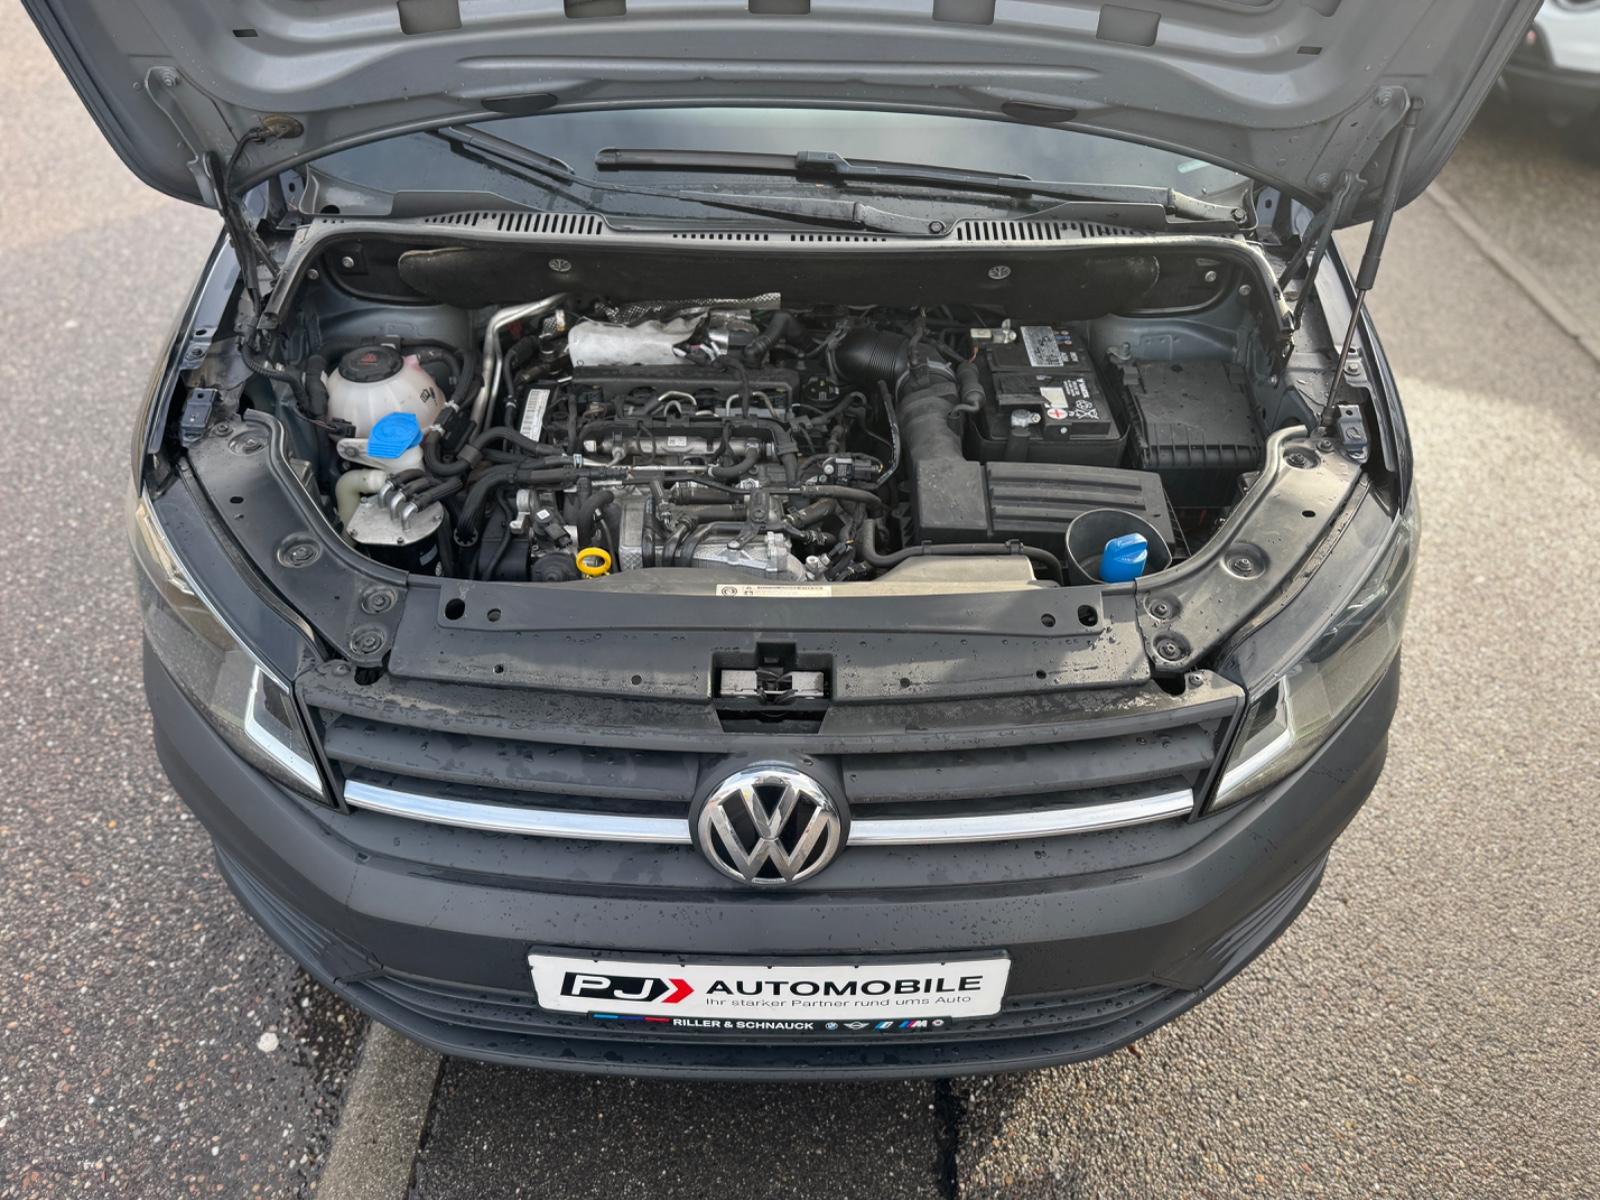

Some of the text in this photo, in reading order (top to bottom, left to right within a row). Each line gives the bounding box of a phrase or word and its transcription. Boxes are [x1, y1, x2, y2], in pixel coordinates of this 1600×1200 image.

[571, 974, 983, 1000] PJ AUTOMOBILE
[706, 998, 726, 1006] Ihr
[731, 998, 787, 1007] starker
[791, 999, 850, 1007] Partner
[854, 998, 890, 1007] rund
[935, 995, 972, 1004] Auto
[673, 1018, 814, 1031] RILLER & SCHNAUCK
